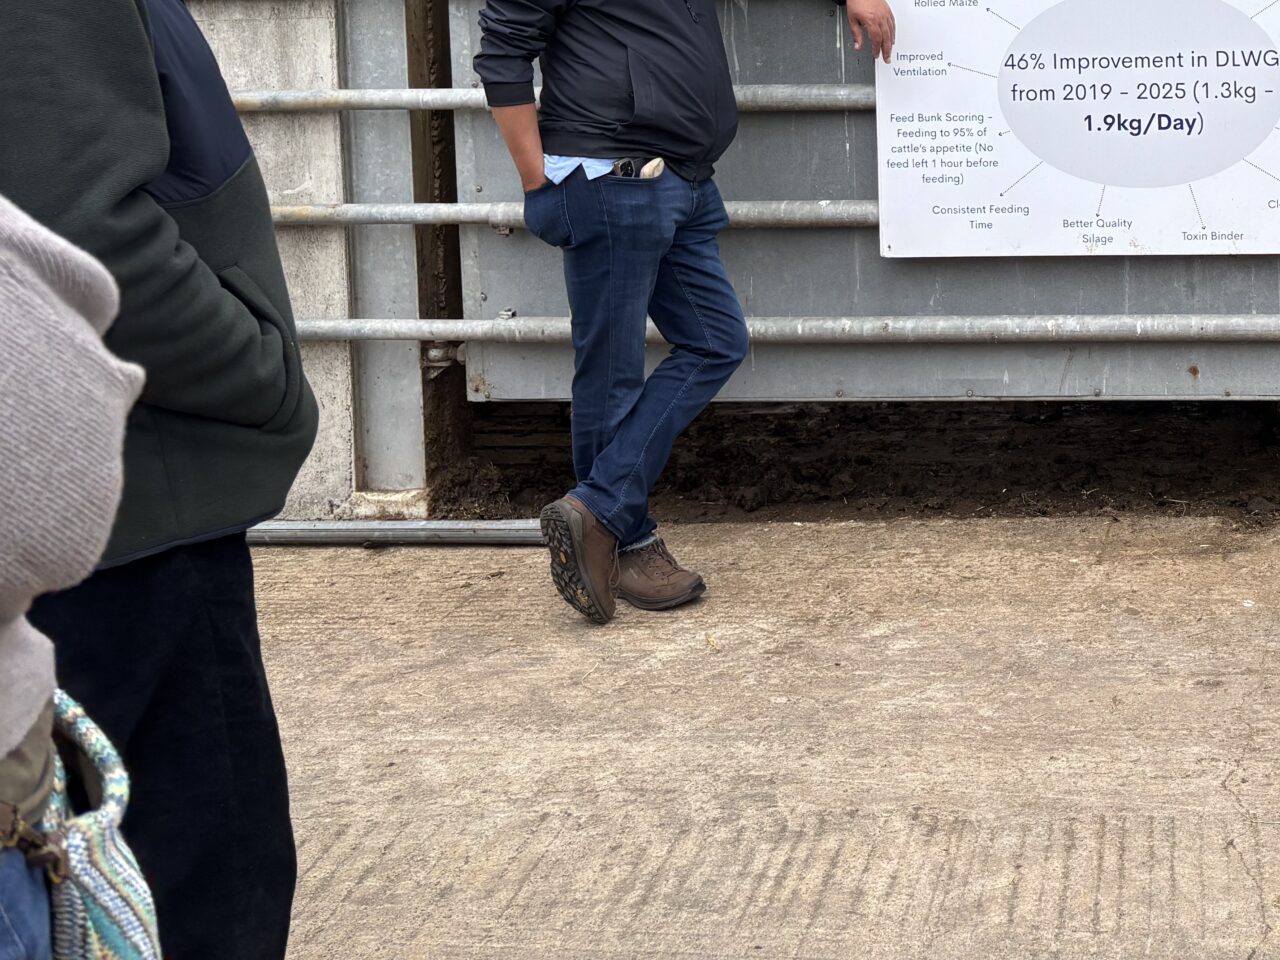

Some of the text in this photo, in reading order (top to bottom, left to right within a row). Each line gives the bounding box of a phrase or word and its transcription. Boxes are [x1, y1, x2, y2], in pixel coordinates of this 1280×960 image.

[896, 52, 943, 63] Improved
[1004, 49, 1280, 74] 46% Improvement in DLWG
[893, 66, 947, 76] Ventilation
[1011, 84, 1055, 101] from
[1062, 84, 1112, 100] 2019
[1137, 82, 1186, 100] 2025
[1193, 79, 1257, 104] (1.3kg
[890, 114, 915, 122] Feed
[918, 113, 942, 122] Bunk
[945, 113, 985, 124] Scoring
[1084, 112, 1204, 137] 1.9kg/Day)
[897, 127, 987, 140] Feeding to 95% of
[891, 143, 993, 155] cattle's appetite (No
[886, 158, 999, 168] feed left 1 hour before
[922, 173, 964, 185] feeding)
[932, 204, 1029, 216] Consistent Feeding
[970, 220, 993, 229] Time
[1062, 219, 1133, 230] Better Quality
[1082, 234, 1113, 245] Silage
[1182, 231, 1244, 241] Toxin Binder
